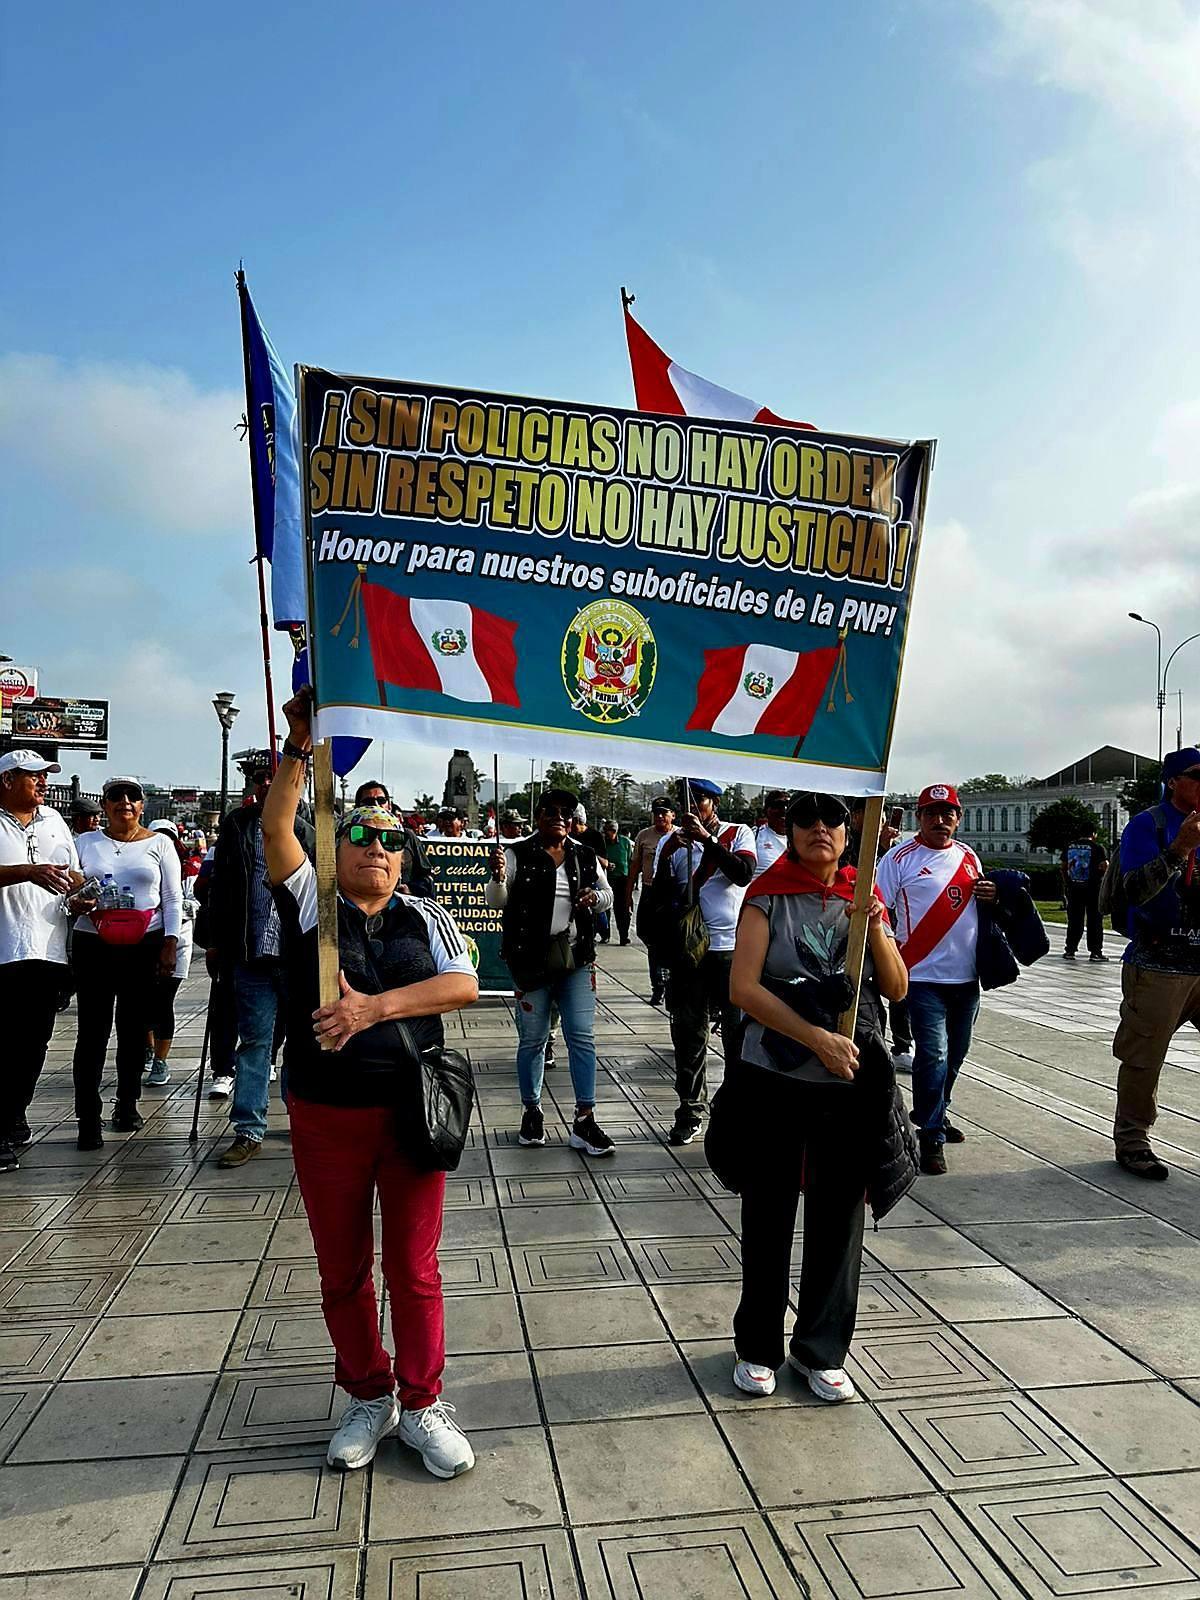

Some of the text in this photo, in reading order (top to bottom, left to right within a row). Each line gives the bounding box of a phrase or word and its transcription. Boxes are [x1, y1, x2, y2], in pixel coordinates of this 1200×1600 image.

[321, 388, 425, 449] ¡SIN
[428, 400, 619, 474] POLICIAS
[624, 422, 683, 482] NO
[689, 430, 766, 492] HAY
[311, 449, 912, 586] SIN RESPETO NO HAY JUSTICIA!
[406, 543, 475, 573] para
[480, 550, 604, 591] nuestros
[609, 567, 769, 616] suboficiales
[774, 589, 806, 621] de
[809, 593, 833, 627] la
[837, 598, 898, 636] PNP!
[595, 691, 619, 703] PATRIA
[424, 844, 490, 857] ACIONAL
[446, 862, 488, 876] cuida
[456, 895, 464, 905] Y
[947, 885, 963, 910] 9
